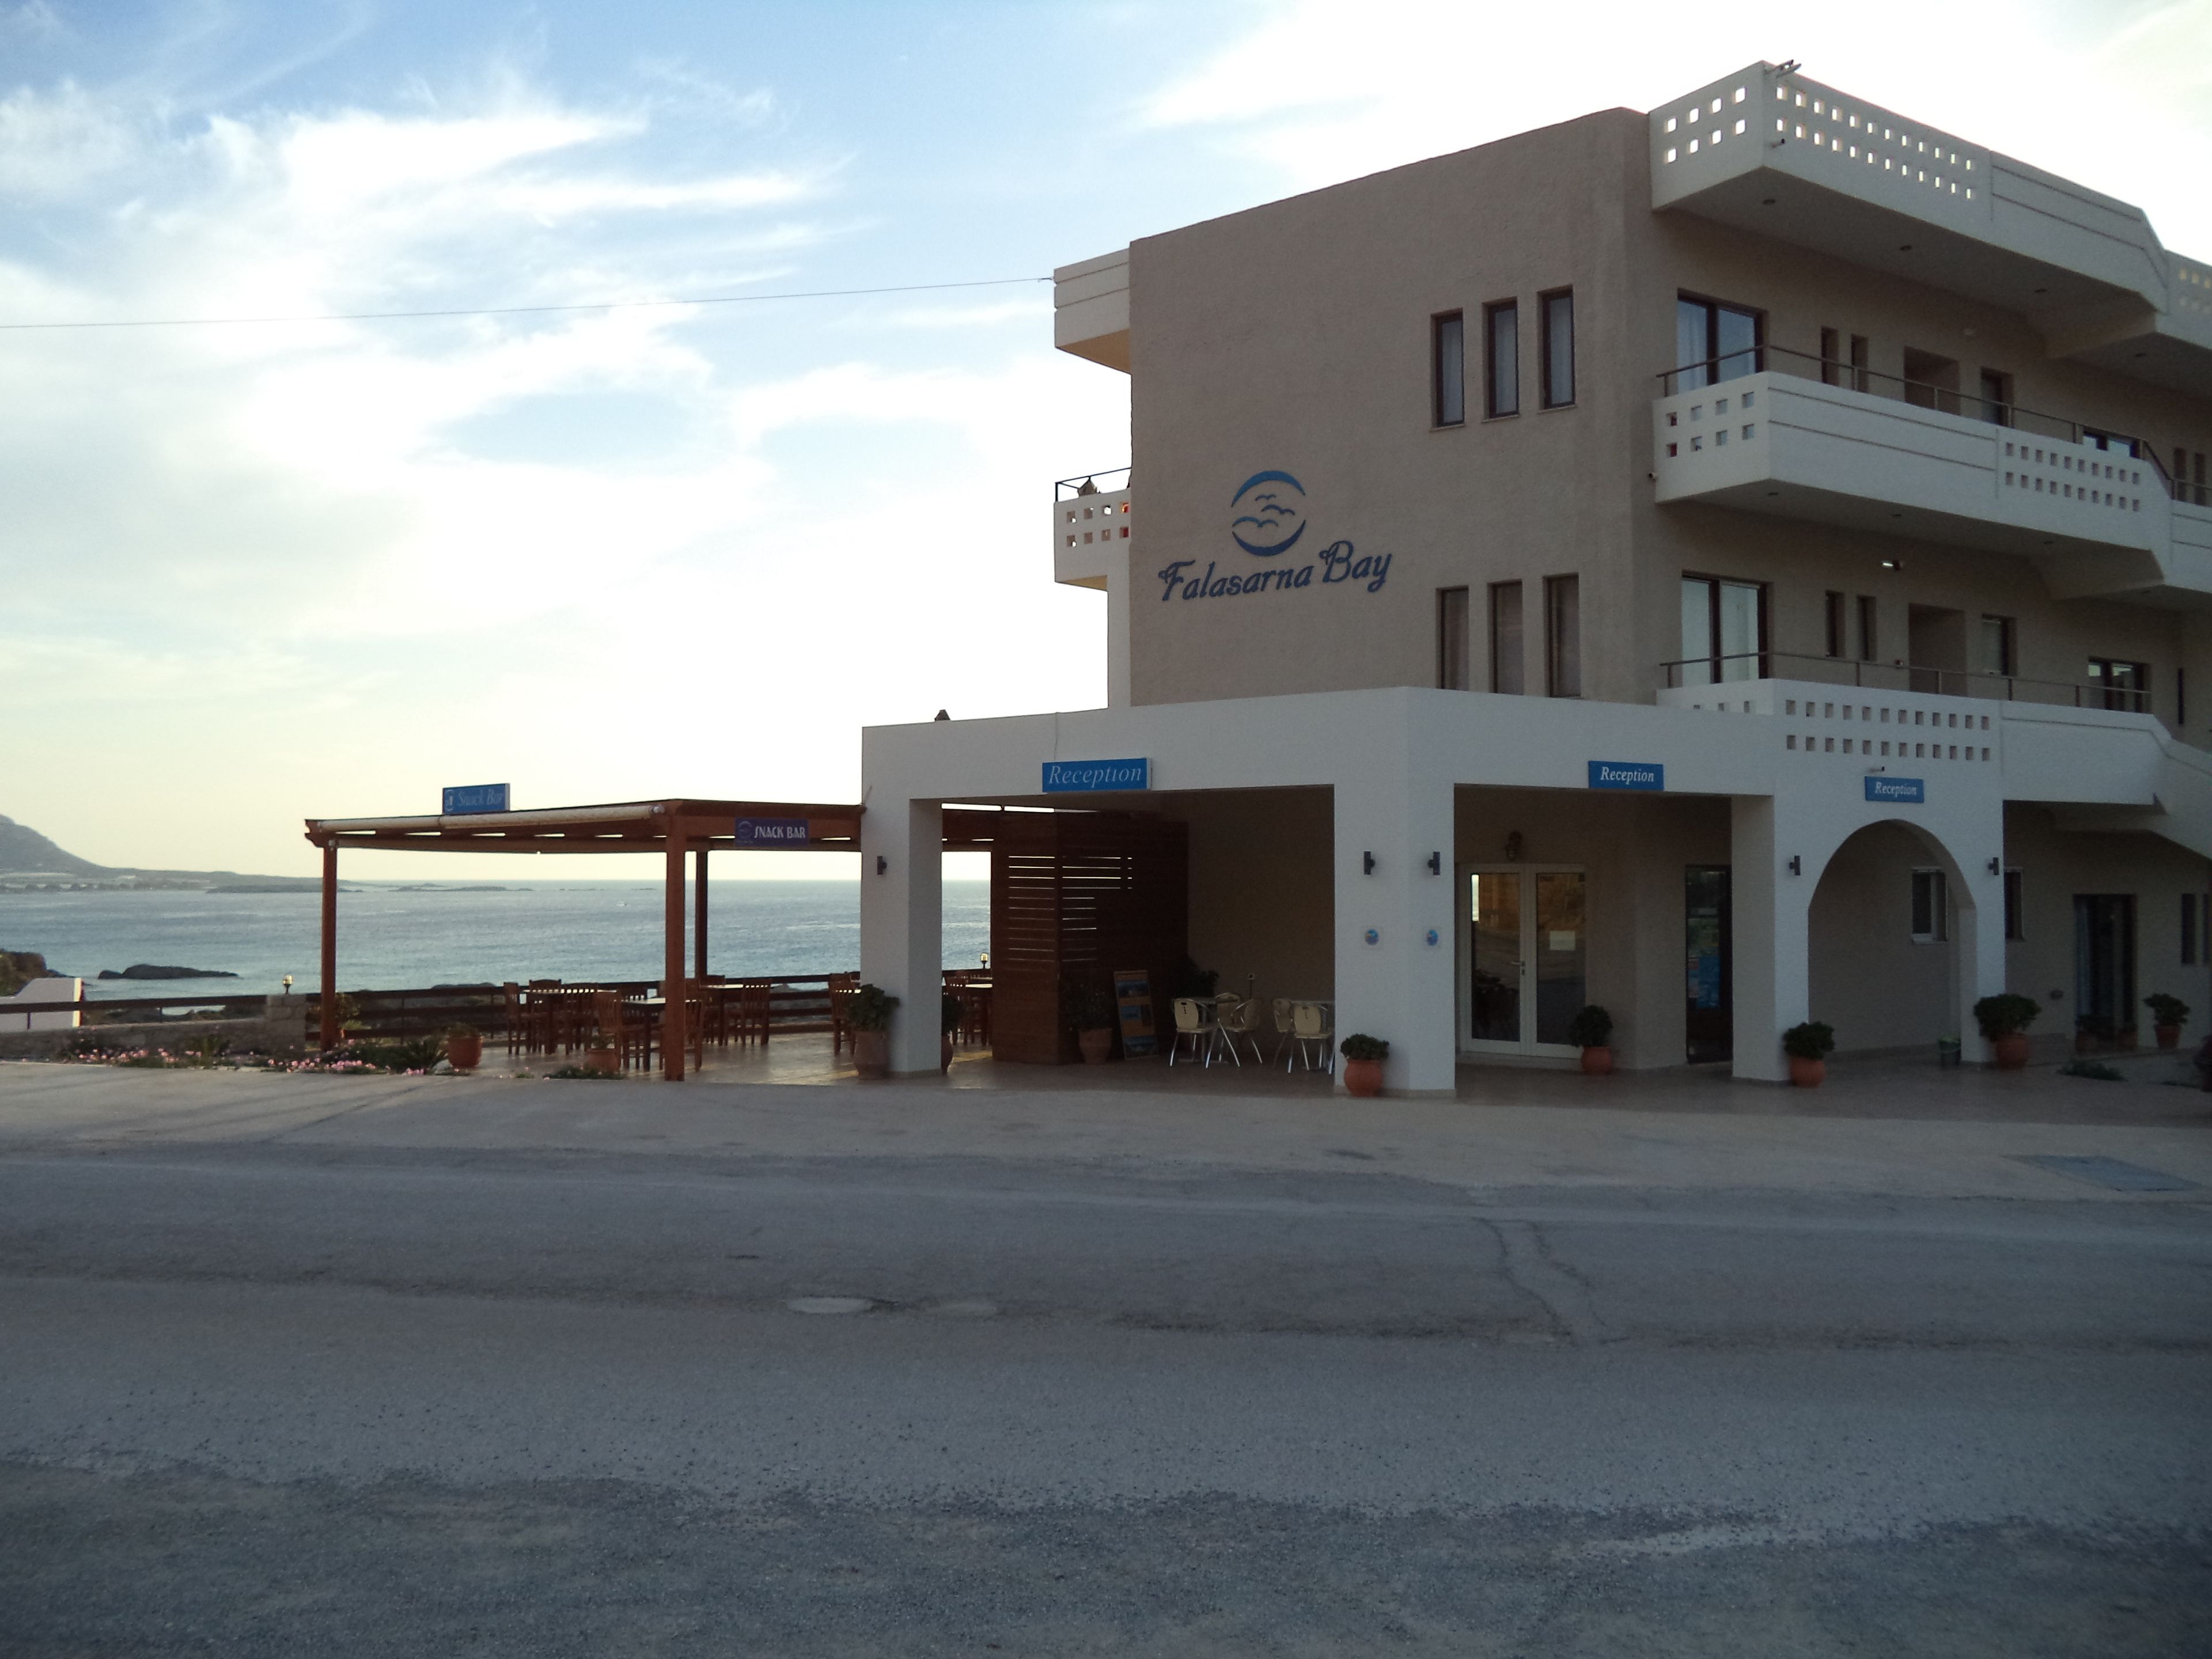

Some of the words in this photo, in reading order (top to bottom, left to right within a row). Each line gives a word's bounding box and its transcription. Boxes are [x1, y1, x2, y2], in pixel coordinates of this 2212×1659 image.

[1158, 560, 1314, 601] Falasarna
[1319, 540, 1392, 593] Bay
[1048, 765, 1142, 788] Reception
[1600, 766, 1654, 785] Reception
[1875, 781, 1917, 798] Reception
[754, 826, 784, 839] SNACK
[786, 826, 806, 839] BAR
